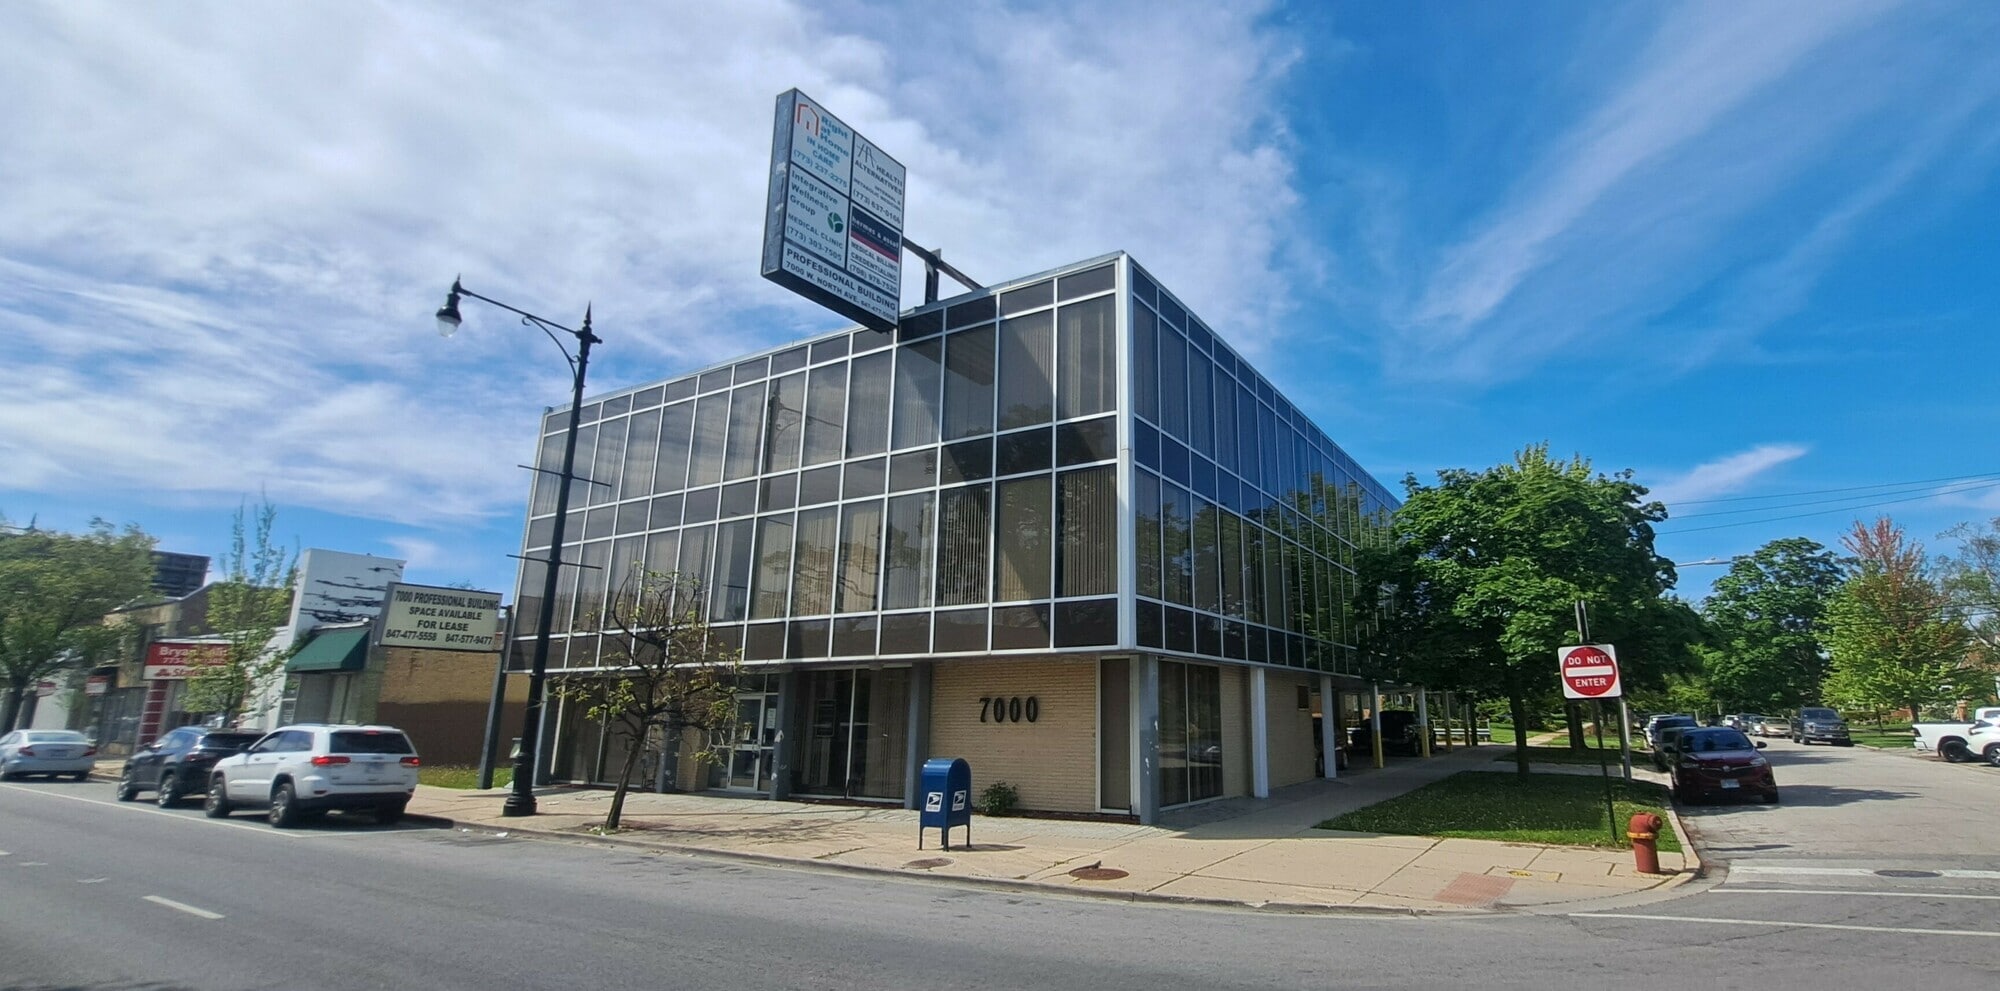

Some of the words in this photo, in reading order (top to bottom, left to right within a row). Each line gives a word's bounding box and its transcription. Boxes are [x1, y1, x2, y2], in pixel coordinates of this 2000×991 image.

[821, 125, 830, 136] at
[822, 116, 848, 139] Right
[806, 136, 816, 146] IN
[817, 144, 840, 163] HOME
[820, 133, 849, 157] Home
[794, 149, 813, 167] (773)
[812, 150, 834, 168] CARE
[855, 160, 902, 195] ALTERNATIVES
[876, 165, 902, 187] HEALTH
[792, 170, 838, 205] Integrative
[792, 182, 829, 212] Wellness
[790, 194, 816, 216] Group
[786, 225, 806, 242] (773)
[788, 212, 819, 236] MEDICAL
[820, 232, 843, 250] CLINIC
[850, 252, 897, 281] CREDENTIALING
[786, 261, 804, 276] 7000
[806, 272, 815, 280] W.
[816, 277, 842, 295] NORTH
[787, 248, 855, 290] PROFESSIONAL
[858, 286, 896, 310] BUILDING
[396, 590, 414, 602] 7000
[414, 592, 466, 608] PROFESSIONAL
[467, 598, 499, 610] BUILDING
[409, 606, 437, 616] SPACE
[438, 609, 482, 620] AVAILABLE
[386, 628, 438, 641] 847-477-5558
[417, 620, 436, 629] FOR
[440, 622, 469, 632] LEASE
[1568, 657, 1582, 666] DO
[1586, 655, 1606, 664] NOT
[1576, 678, 1607, 688] ENTER
[979, 696, 1038, 723] 7000
